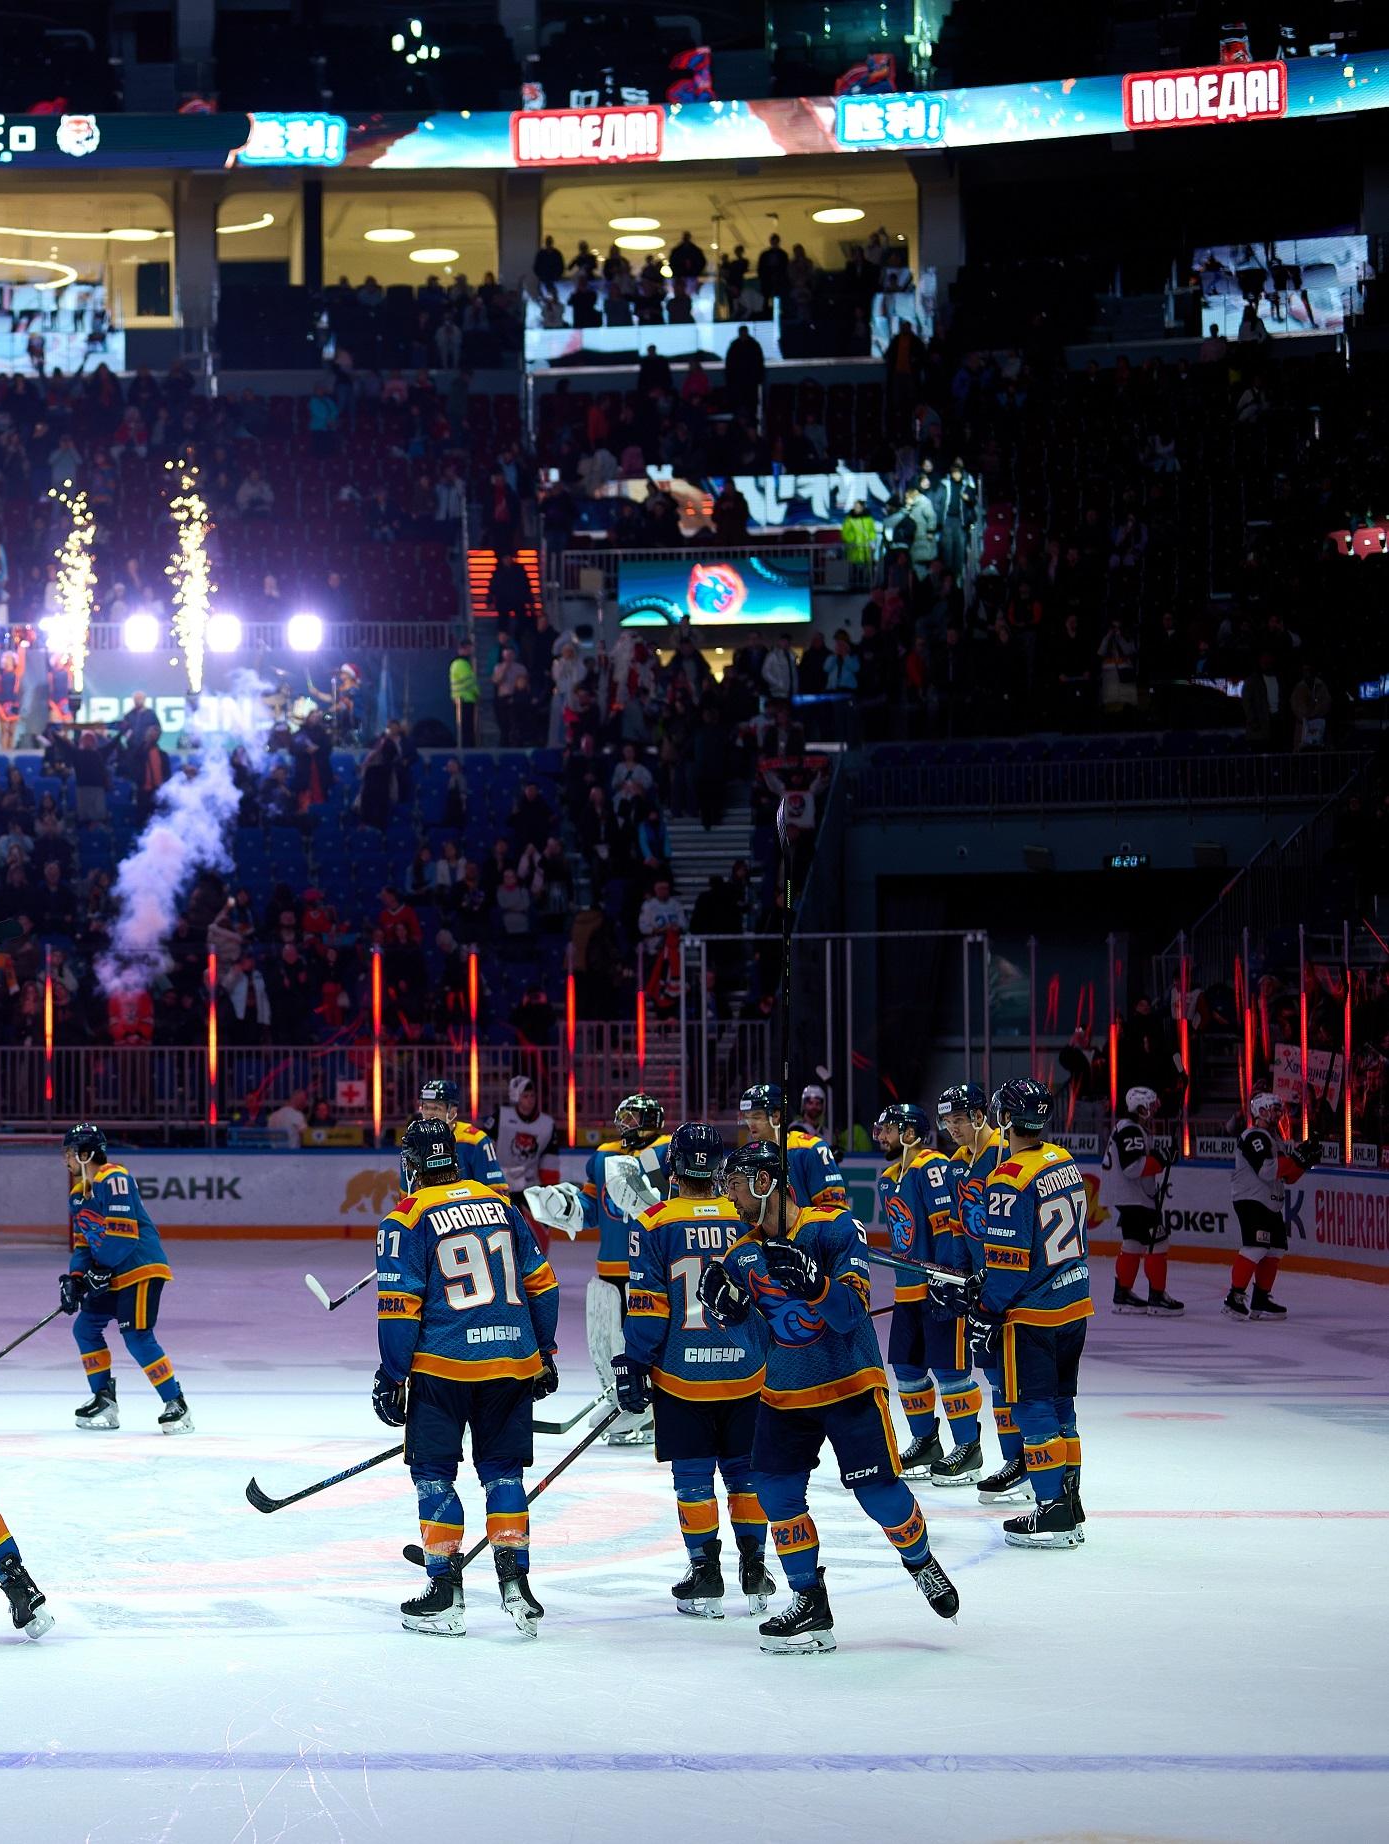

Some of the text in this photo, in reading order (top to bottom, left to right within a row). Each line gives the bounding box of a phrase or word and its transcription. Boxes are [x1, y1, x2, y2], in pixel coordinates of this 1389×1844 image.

[1132, 68, 1280, 123] ПОБЕДА!
[518, 111, 658, 160] ПОБЕДА!
[1038, 1104, 1048, 1113] 27
[432, 1143, 444, 1155] 91
[1123, 1138, 1144, 1151] 25
[1199, 1139, 1236, 1153] KHL.RU
[1252, 1139, 1264, 1152] 8
[427, 1158, 452, 1167] СИБУР
[695, 1153, 707, 1165] 15
[106, 1176, 129, 1196] 10
[138, 1177, 242, 1200] БАНК
[988, 1193, 1017, 1217] 27
[427, 1202, 509, 1236] WAGNER
[1038, 1188, 1088, 1267] 27
[685, 1227, 721, 1250] FOO
[436, 1229, 523, 1311] 91
[466, 1325, 521, 1344] СИБУР
[684, 1347, 746, 1363] СИБУР
[845, 1465, 879, 1481] CCM
